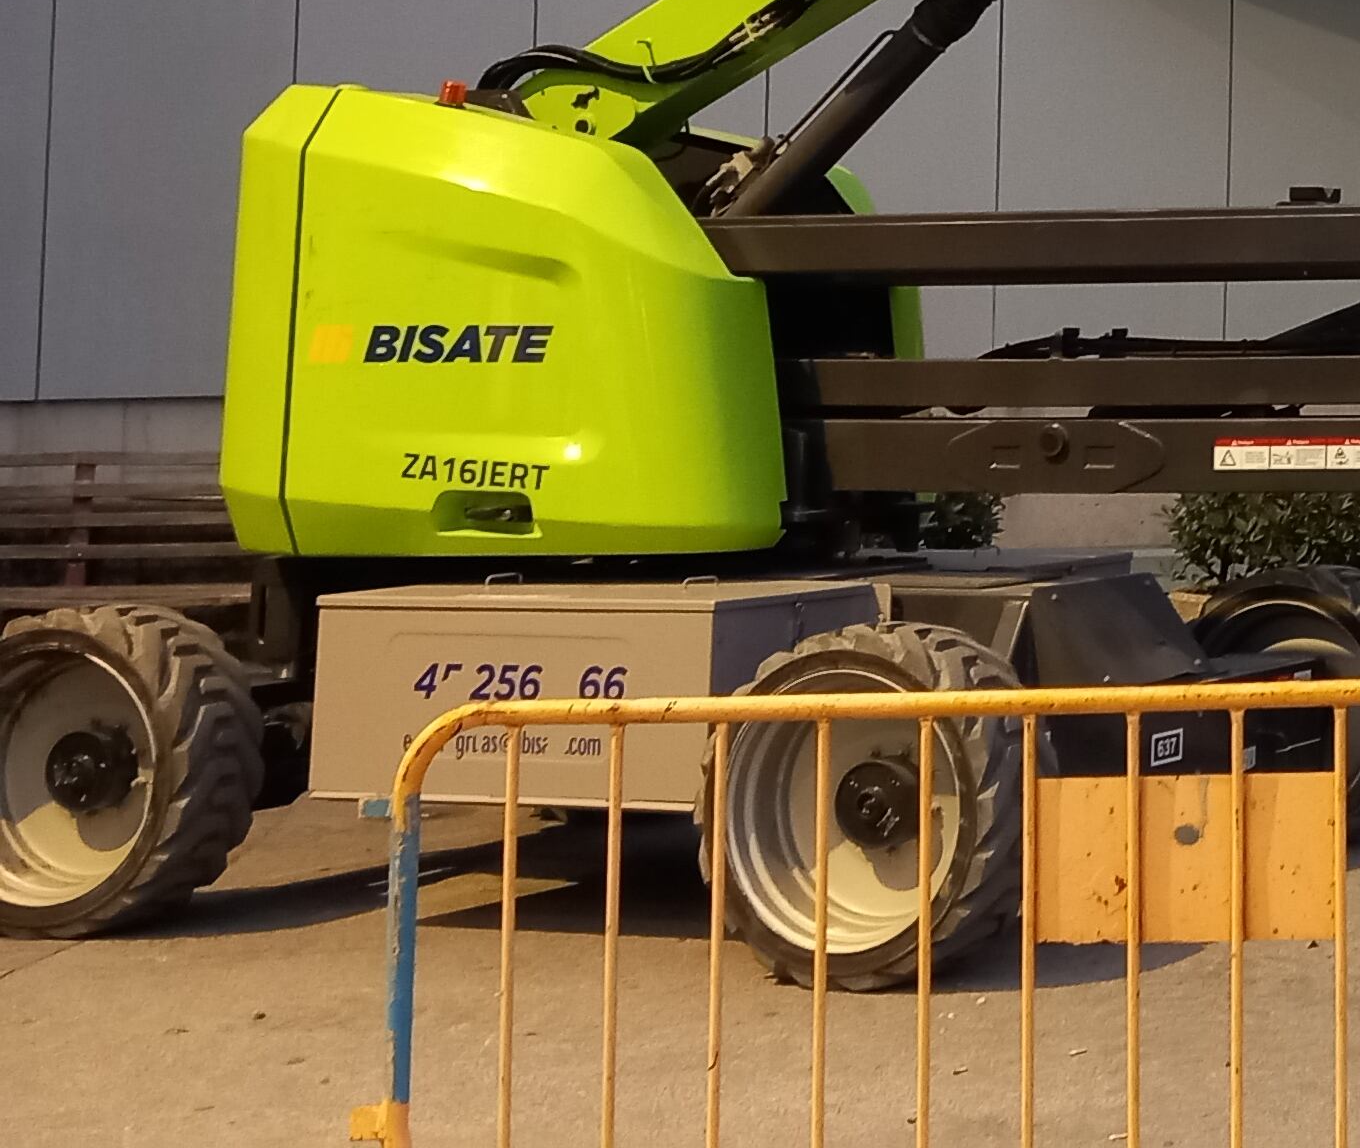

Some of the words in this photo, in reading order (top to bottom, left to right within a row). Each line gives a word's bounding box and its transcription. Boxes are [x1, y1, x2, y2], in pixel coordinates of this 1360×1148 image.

[363, 325, 554, 363] BISATE
[401, 453, 550, 490] ZA16JERT
[469, 664, 543, 700] 256
[1157, 737, 1178, 758] 637
